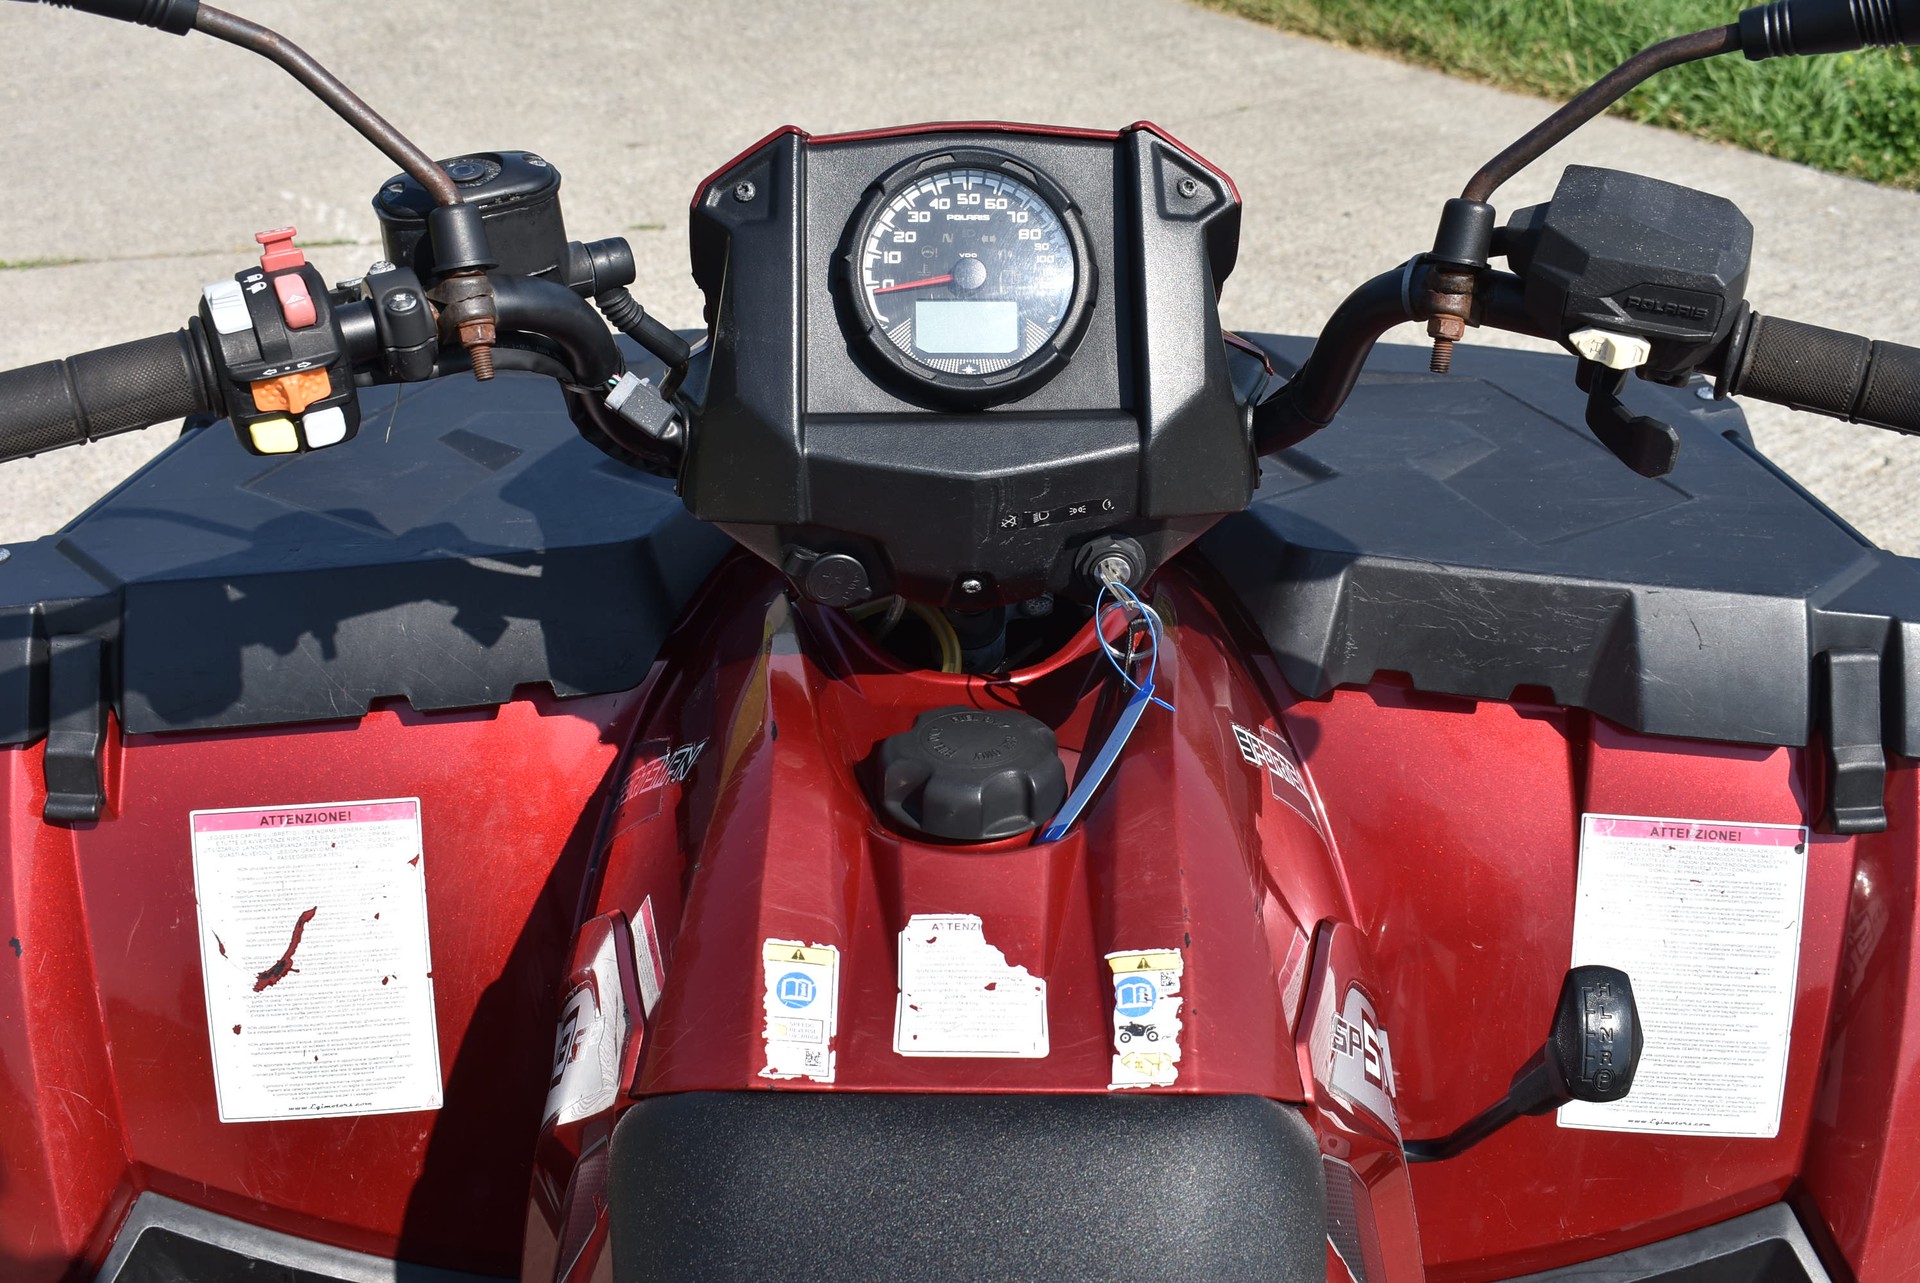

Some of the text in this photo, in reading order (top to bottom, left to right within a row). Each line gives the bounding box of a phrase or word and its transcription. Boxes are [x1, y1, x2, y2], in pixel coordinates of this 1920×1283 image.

[929, 198, 950, 209] 40
[957, 193, 980, 205] 50
[984, 198, 1008, 209] 60
[907, 211, 930, 222] 30
[1006, 211, 1028, 223] 70
[893, 231, 916, 243] 20
[1018, 228, 1041, 240] 80
[1034, 242, 1050, 251] 90
[883, 251, 901, 264] 10
[1036, 255, 1055, 263] 100
[1626, 294, 1709, 319] POLARIS
[260, 811, 352, 826] ATTENZIONE!
[1597, 982, 1612, 996] H
[1599, 1005, 1612, 1019] L
[1599, 1027, 1613, 1043] N
[1599, 1050, 1613, 1066] R
[1597, 1073, 1612, 1088] P
